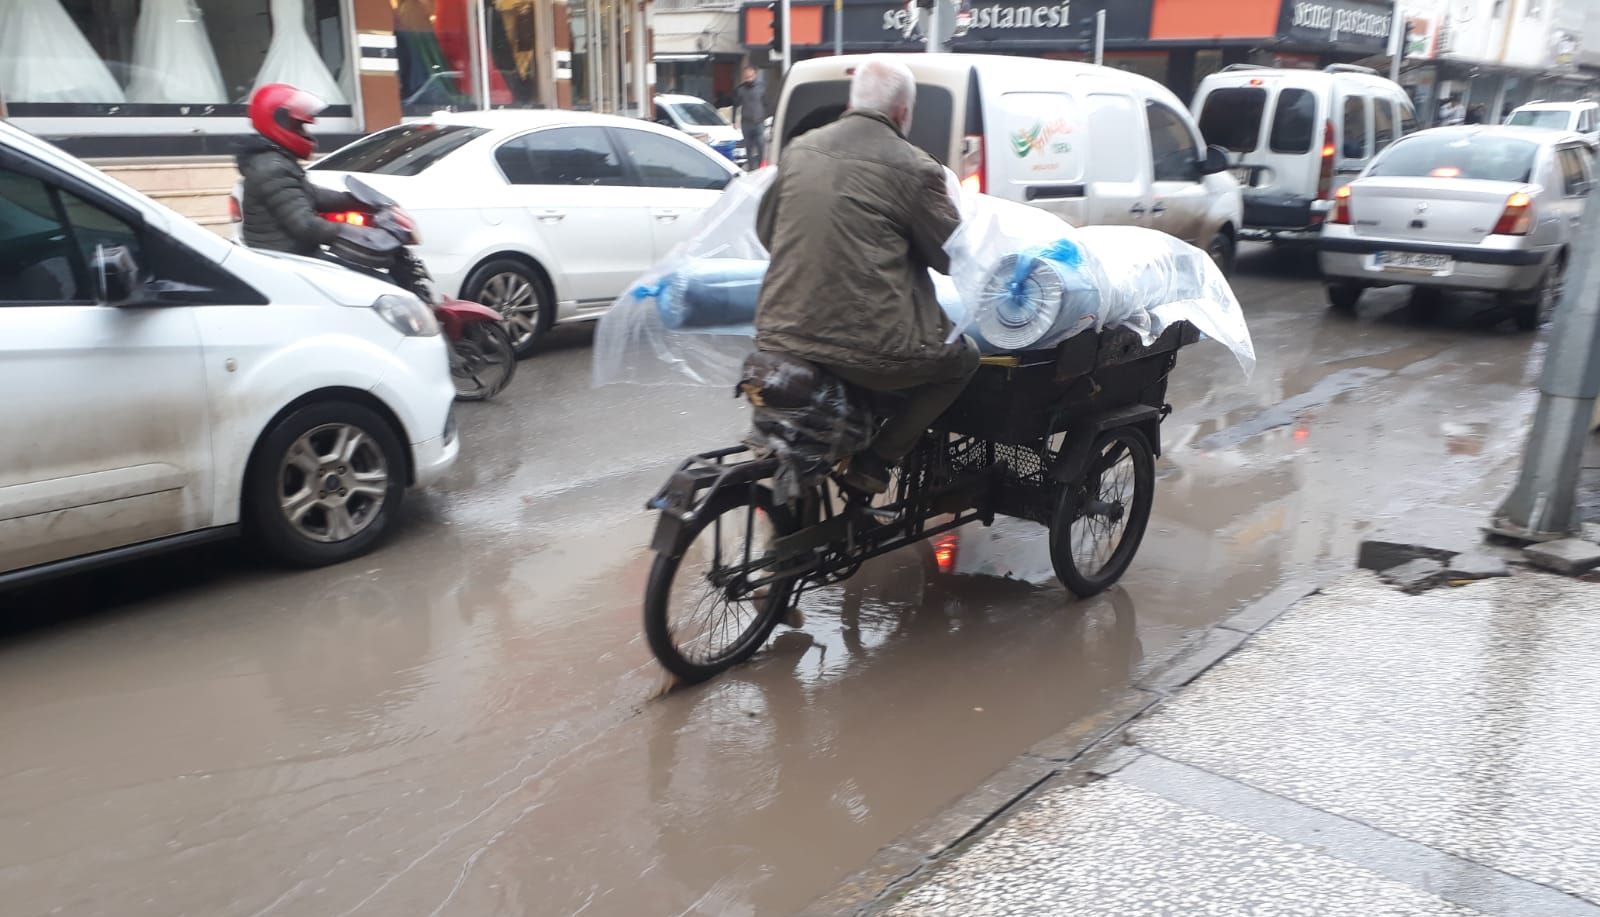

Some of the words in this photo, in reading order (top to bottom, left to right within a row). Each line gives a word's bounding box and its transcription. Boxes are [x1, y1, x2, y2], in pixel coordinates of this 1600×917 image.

[968, 0, 1071, 29] astanesi
[1293, 2, 1332, 29] sema
[1329, 8, 1392, 42] pastanesi
